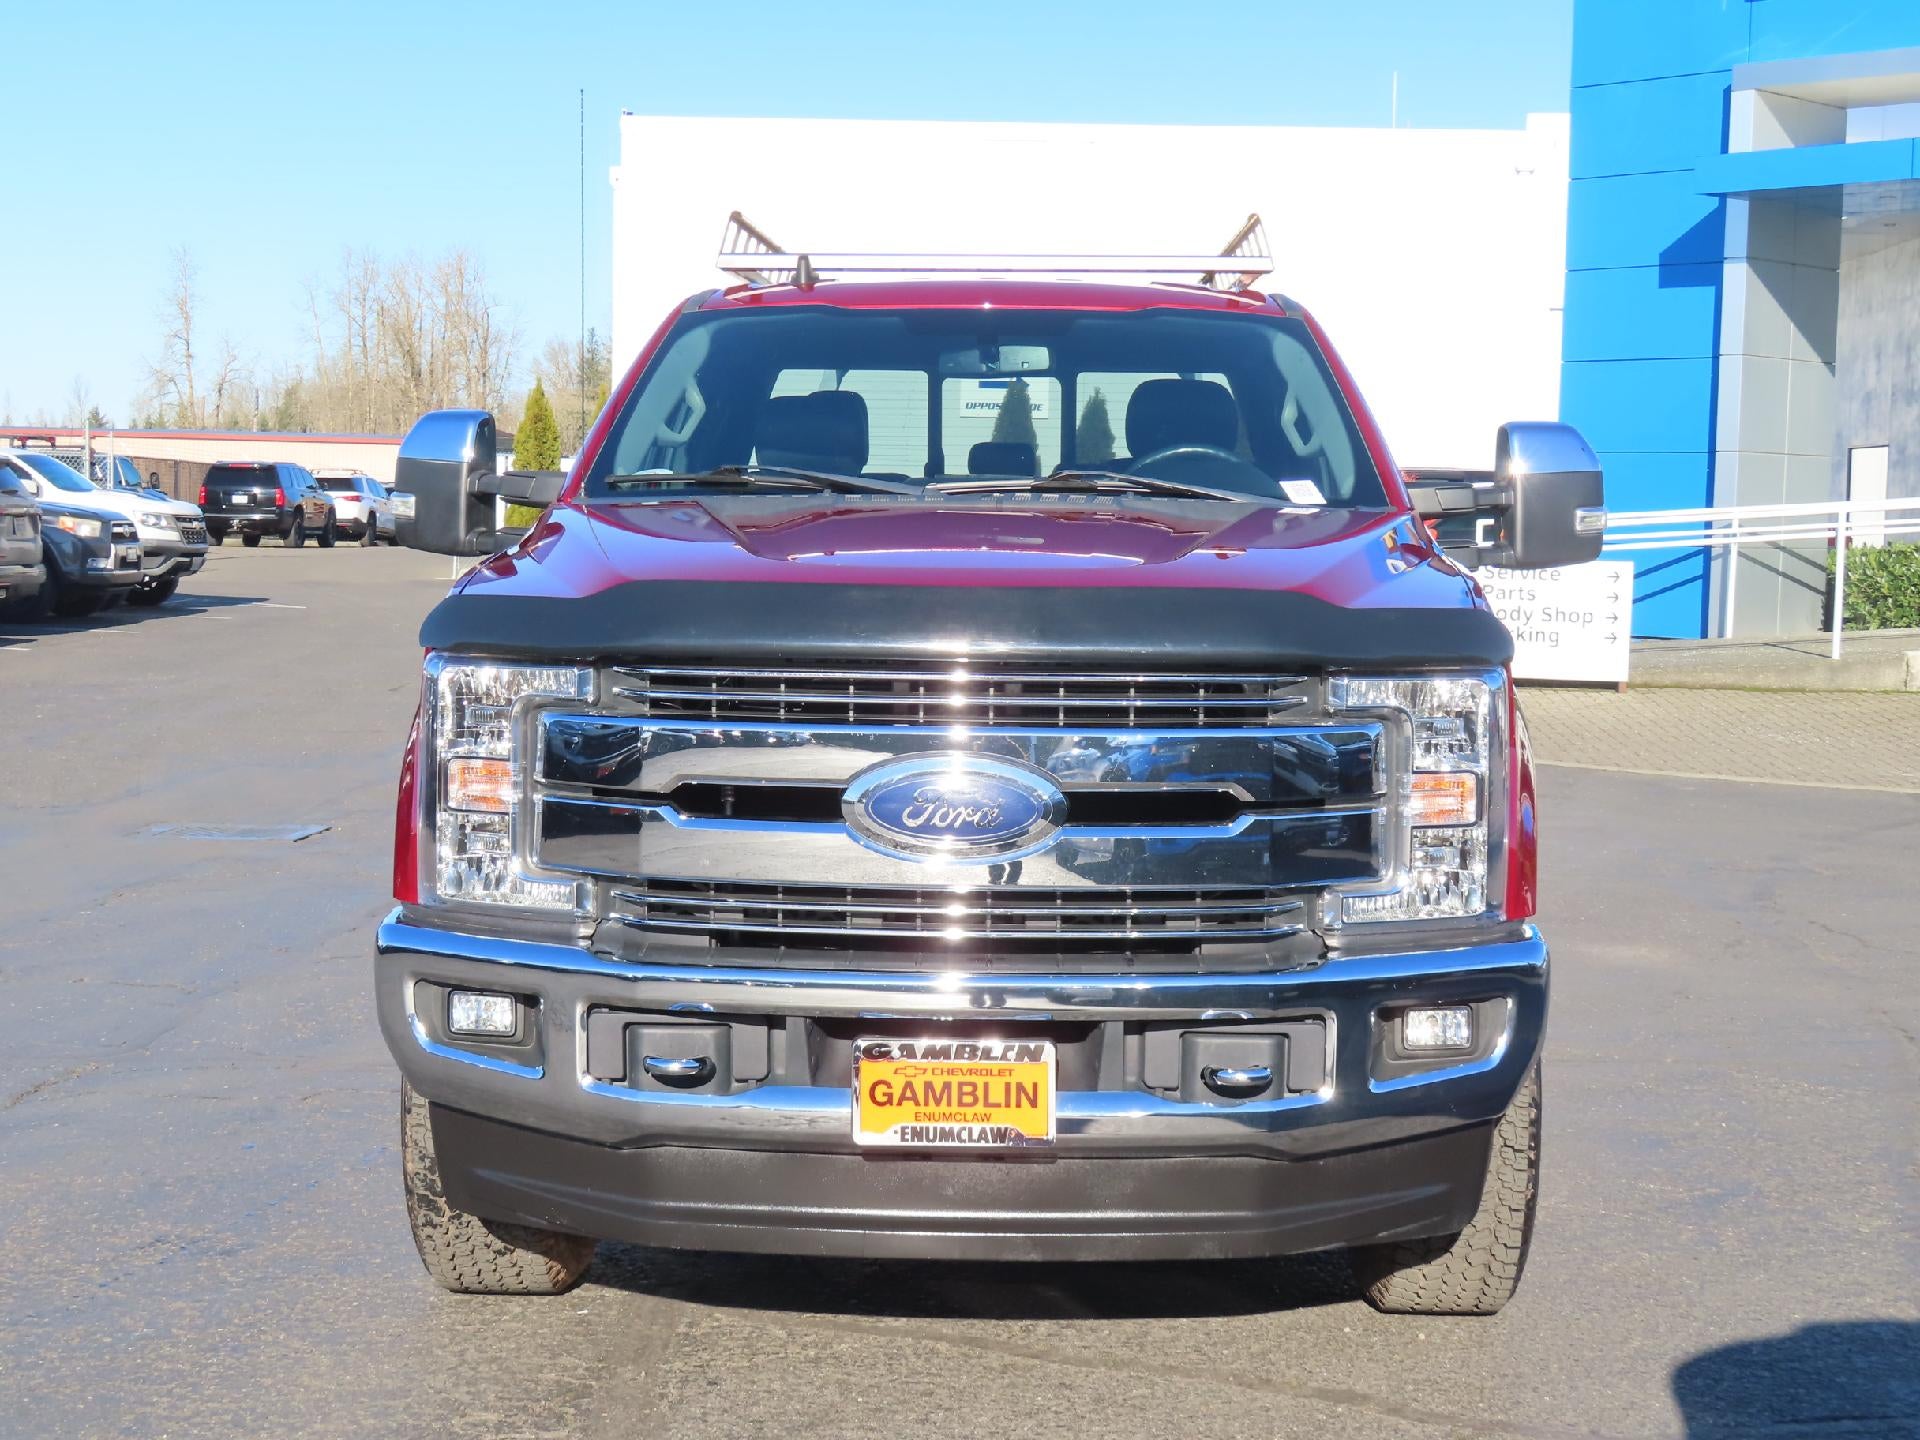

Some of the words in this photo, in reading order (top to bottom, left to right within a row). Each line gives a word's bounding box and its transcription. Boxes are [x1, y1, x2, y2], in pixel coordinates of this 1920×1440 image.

[1484, 566, 1561, 581] Service
[1483, 585, 1536, 601] Parts
[1496, 606, 1533, 626] ody
[1541, 607, 1593, 628] Shop
[902, 786, 1003, 828] Ford
[862, 1043, 1045, 1062] GAMBLIN
[932, 1067, 1015, 1077] CHEVROLET
[869, 1079, 1038, 1109] GAMBLIN
[914, 1112, 992, 1123] ENUMCLAW
[900, 1126, 1008, 1144] ENUMCLAW
